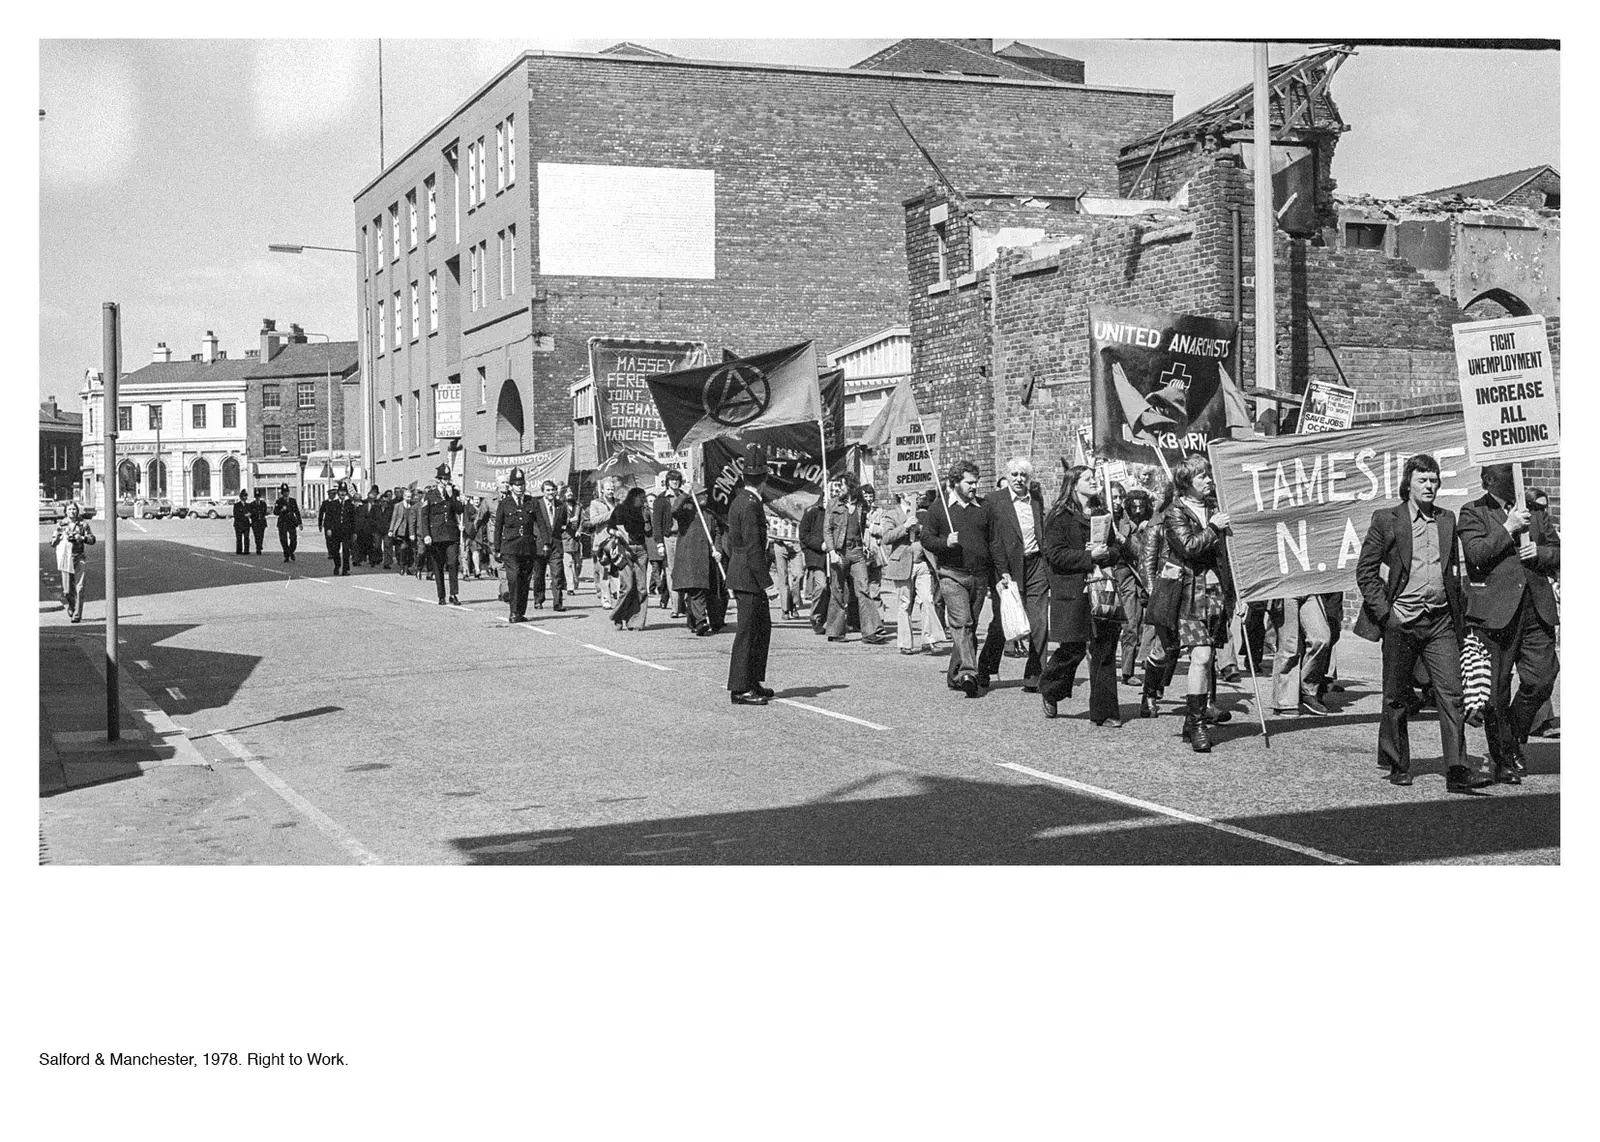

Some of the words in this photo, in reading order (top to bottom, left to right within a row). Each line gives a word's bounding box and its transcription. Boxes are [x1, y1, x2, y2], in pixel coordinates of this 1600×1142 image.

[1094, 322, 1160, 348] UNITED
[1168, 333, 1230, 358] ANARCHISTS
[1489, 332, 1516, 352] FIGHT
[616, 356, 676, 372] MASSEY
[1468, 351, 1542, 376] UNEMPLOYMENT
[607, 373, 650, 388] FERG
[438, 390, 449, 400] TO
[608, 390, 642, 401] JOINT
[1476, 381, 1544, 405] INCREASE
[1305, 413, 1325, 424] SAVE
[1325, 418, 1344, 428] JOBS
[1500, 405, 1526, 424] ALL
[1482, 424, 1548, 448] SPENDING
[486, 453, 552, 465] WARRINGTON
[908, 462, 921, 472] ALL
[896, 472, 932, 484] SPENDING
